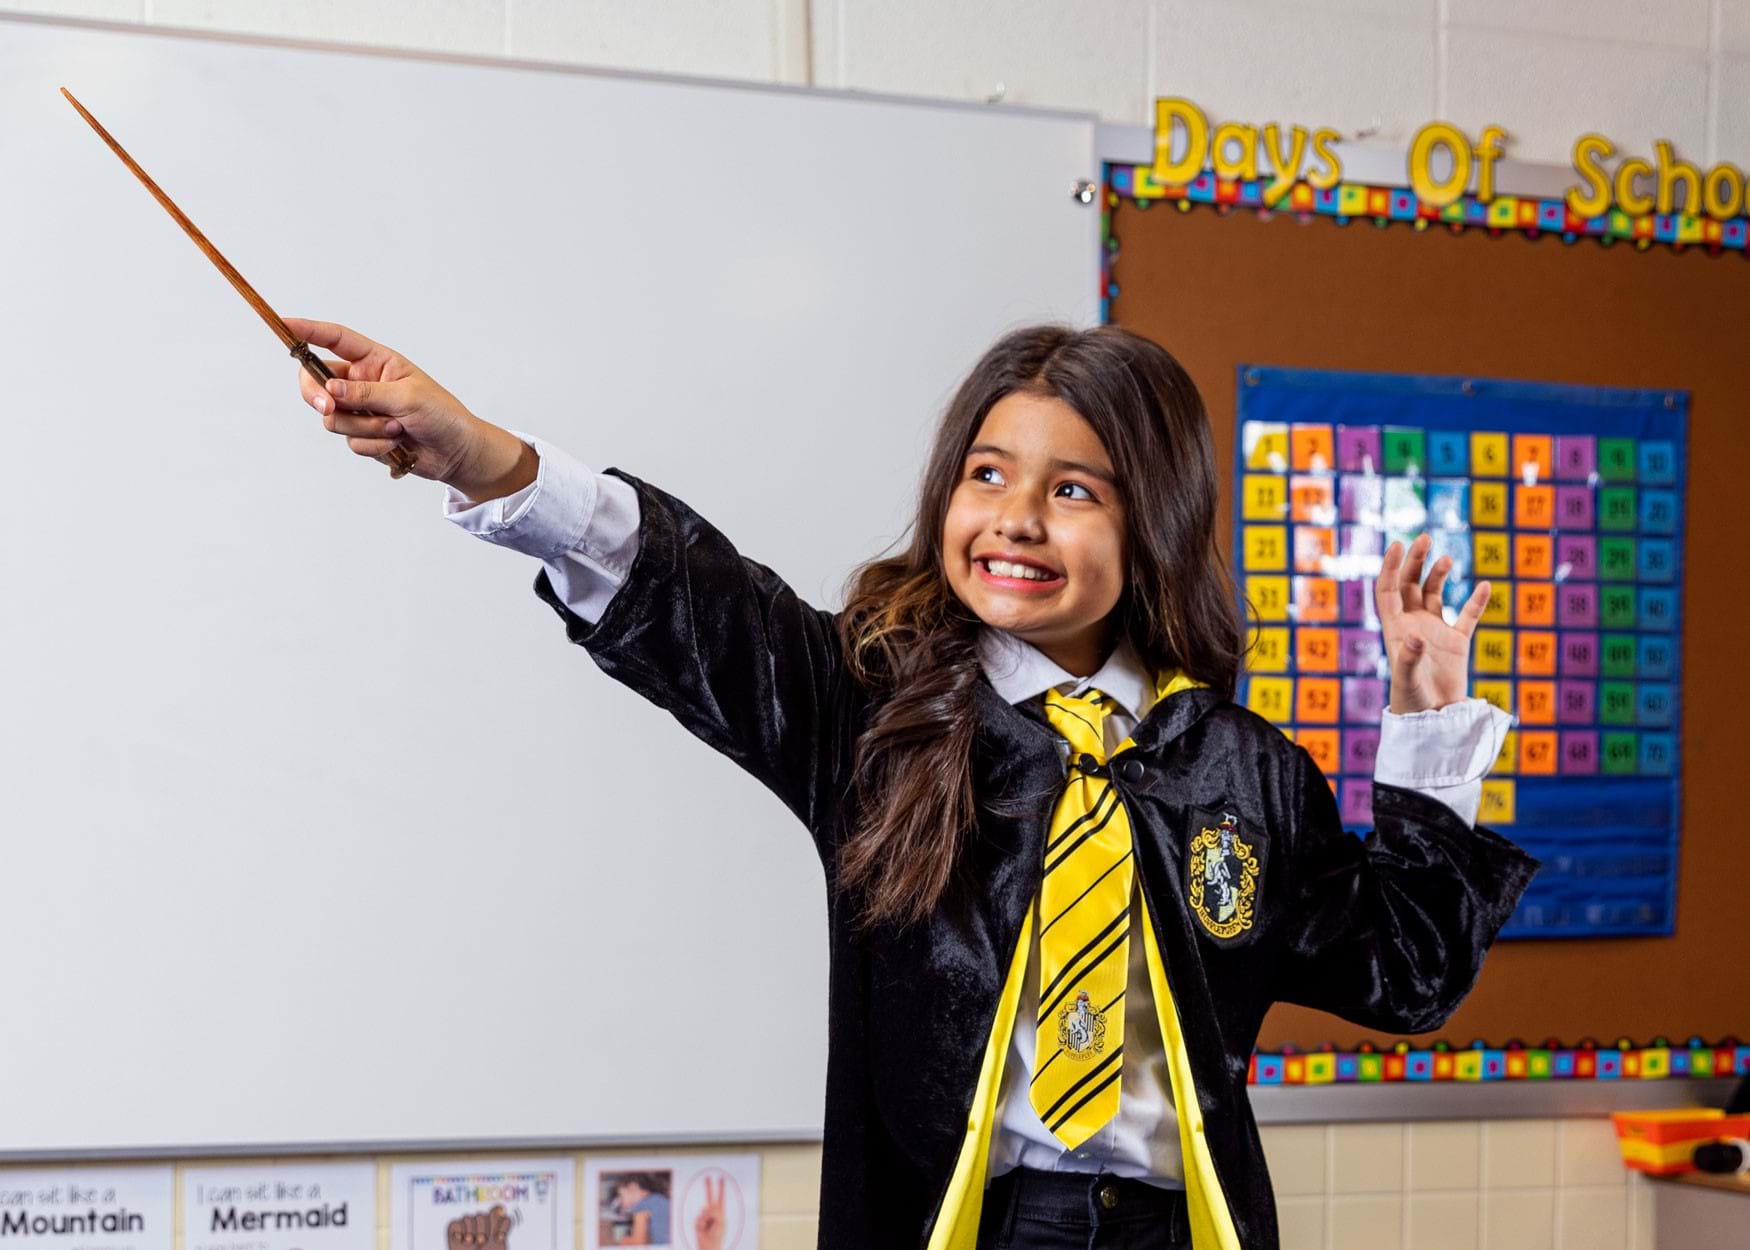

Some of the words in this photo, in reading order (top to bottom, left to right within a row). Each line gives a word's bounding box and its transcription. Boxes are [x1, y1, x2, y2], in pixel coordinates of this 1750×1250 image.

[1153, 97, 1343, 208] Days
[1408, 121, 1507, 207] Of
[1566, 134, 1750, 219] Scho
[1483, 443, 1495, 463] 6
[1570, 448, 1582, 469] 8
[1257, 486, 1276, 507] 11
[1526, 495, 1545, 516] 17
[1257, 536, 1277, 558] 21
[1523, 545, 1543, 567] 27
[1259, 586, 1279, 608] 31
[1526, 592, 1548, 614] 37
[1308, 640, 1332, 661] 42
[1526, 639, 1549, 662] 47
[1259, 688, 1282, 711] 51
[1307, 688, 1332, 712] 52
[1527, 690, 1548, 713] 57
[1527, 739, 1550, 761] 67
[68, 1184, 98, 1205] like
[207, 1187, 242, 1205] can
[275, 1180, 303, 1201] like
[1, 1207, 145, 1236] Mountain
[211, 1201, 348, 1233] Mermaid
